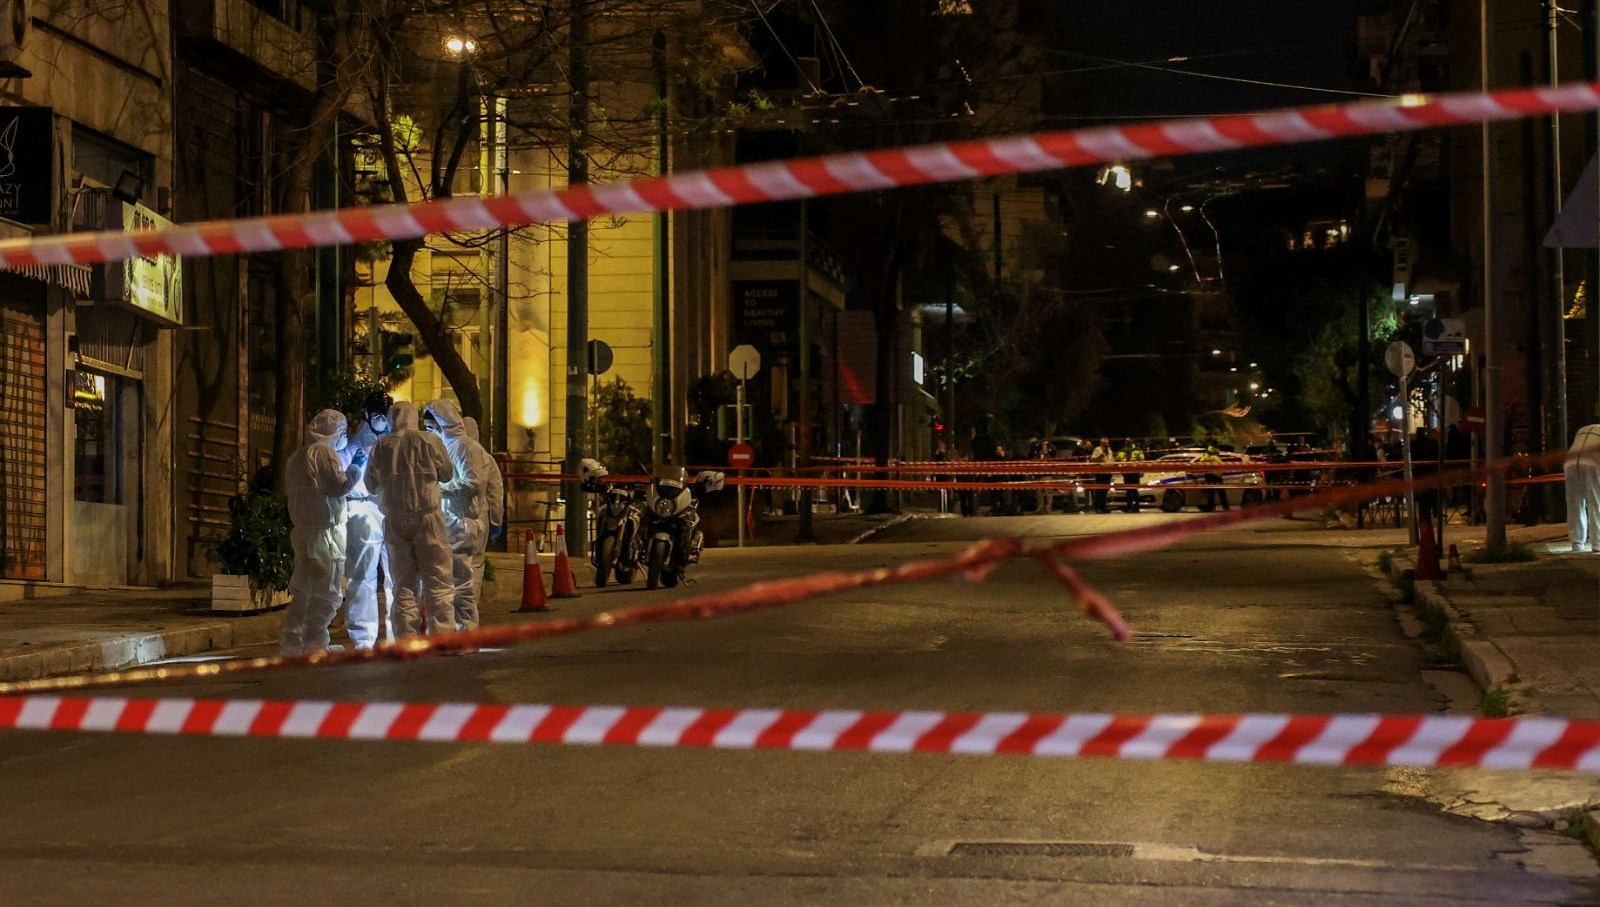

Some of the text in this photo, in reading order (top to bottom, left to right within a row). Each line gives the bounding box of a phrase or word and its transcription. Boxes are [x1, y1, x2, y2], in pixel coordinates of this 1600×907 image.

[743, 288, 779, 298] ACCESS
[743, 299, 757, 308] TO
[743, 309, 785, 317] HEALTHY
[743, 319, 776, 327] LIVING
